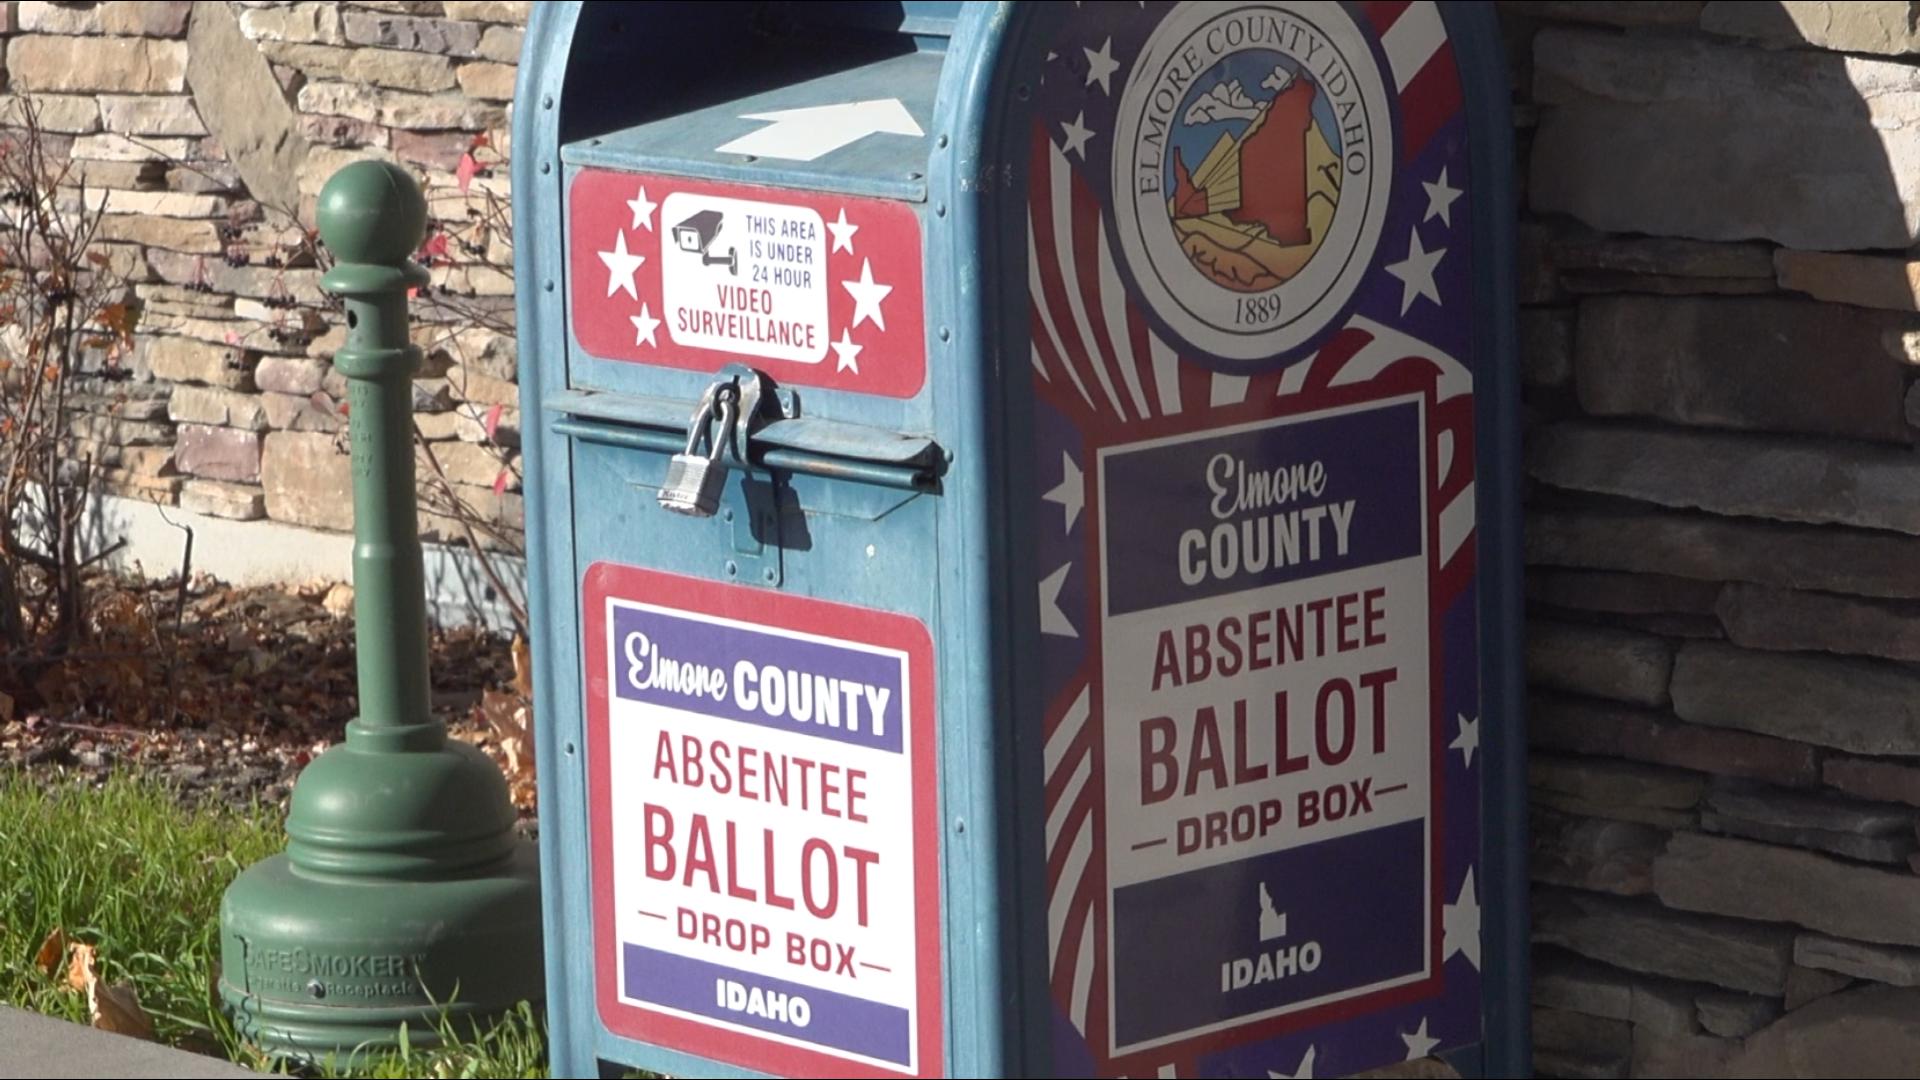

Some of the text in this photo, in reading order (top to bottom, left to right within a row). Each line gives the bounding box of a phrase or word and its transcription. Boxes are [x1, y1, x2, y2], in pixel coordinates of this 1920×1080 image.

[1139, 16, 1367, 196] ELMORE COUNTY IDAHO
[746, 214, 816, 241] THIS AREA
[750, 239, 813, 265] IS UNDER
[717, 283, 773, 315] VIDEO
[752, 264, 812, 289] 24 HOUR
[1233, 292, 1282, 326] 1889
[677, 307, 816, 350] SURVEILLANCE
[1206, 452, 1328, 520] Elmore
[1177, 499, 1356, 587] COUNTY
[1151, 586, 1387, 692] ABSENTEE
[624, 631, 891, 737] Elmore COUNTY
[1139, 666, 1398, 807] BALLOT
[653, 729, 869, 824] ABSENTEE
[1176, 776, 1374, 857] DROP BOX
[643, 801, 880, 929] BALLOT
[676, 905, 857, 980] DROP BOX
[1221, 940, 1322, 994] IDAHO
[716, 978, 811, 1028] IDAHO
